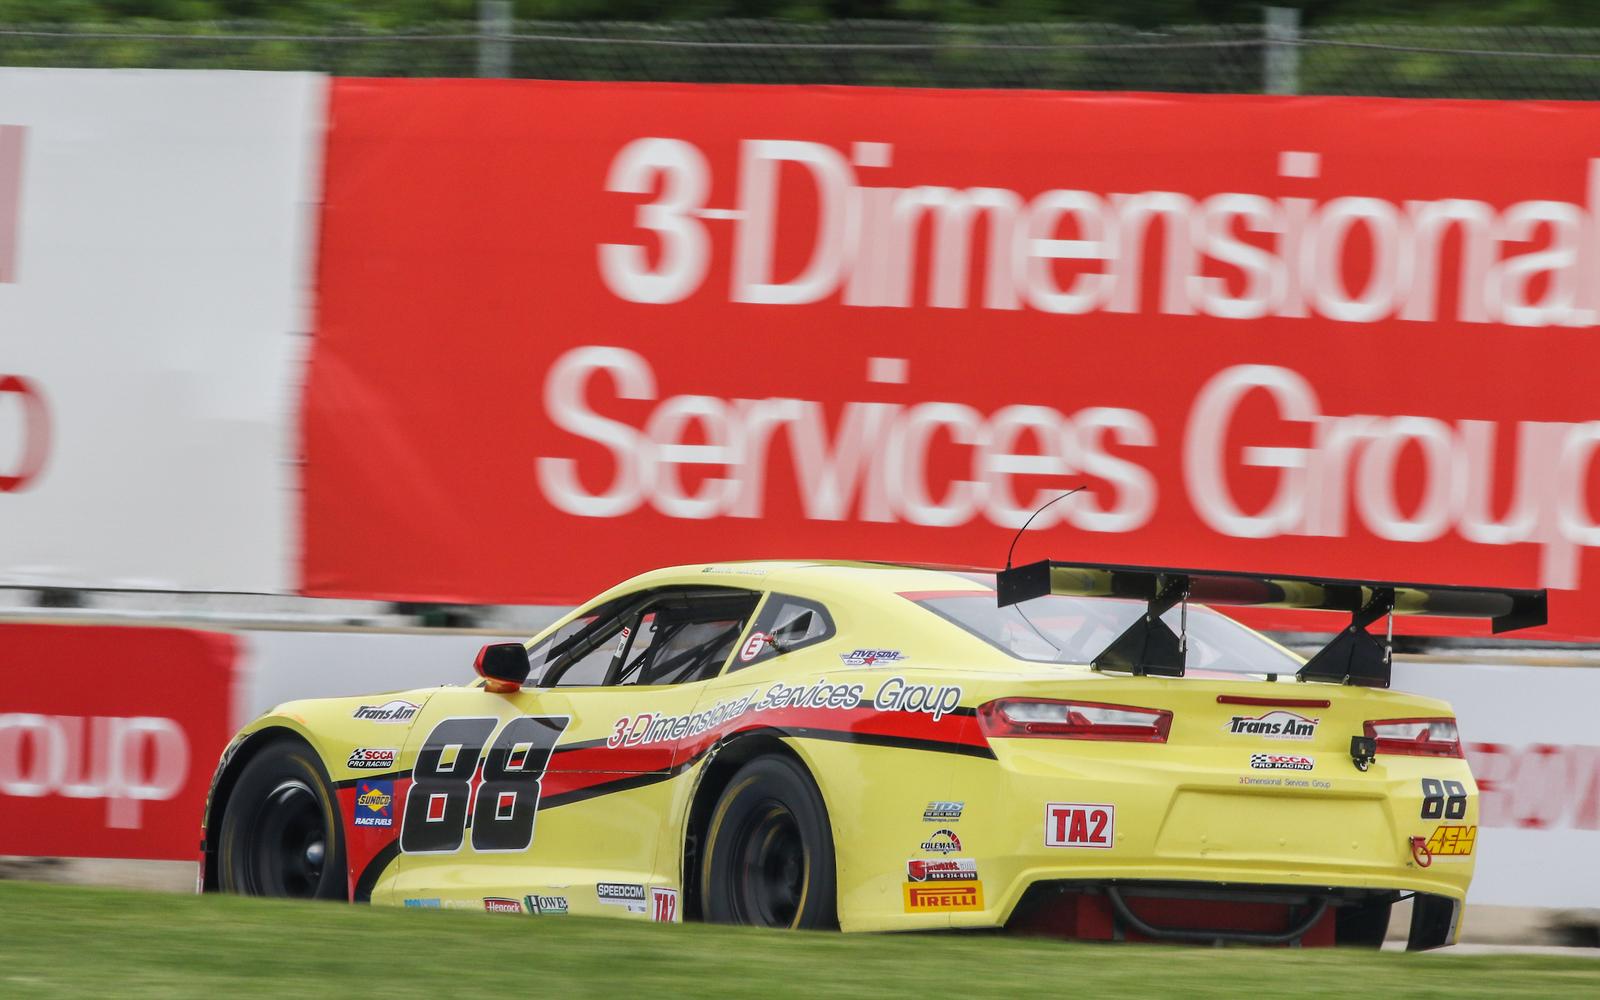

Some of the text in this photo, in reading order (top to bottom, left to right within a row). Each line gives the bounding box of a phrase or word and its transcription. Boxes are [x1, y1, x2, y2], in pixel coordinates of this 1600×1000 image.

[534, 345, 1600, 590] Services Group
[850, 650, 876, 659] FIVE
[353, 705, 416, 720] Trans Am
[607, 676, 961, 749] 3-Dimensional Services Group
[1231, 716, 1314, 736] Trans Am
[364, 750, 393, 760] SCCA
[1268, 755, 1311, 764] SCCA
[348, 760, 391, 768] PRO RACING
[400, 715, 571, 855] 88
[1285, 778, 1309, 787] Services
[1312, 779, 1331, 789] Group
[359, 794, 390, 806] SUNOCO
[1421, 778, 1467, 819] 88
[354, 817, 392, 826] RACE FUELS
[1052, 809, 1108, 843] TA2
[920, 842, 956, 850] COLEMAN
[1421, 826, 1477, 856] AEM
[598, 885, 643, 899] SPEEDCOM
[909, 887, 977, 907] PIRELLI
[654, 892, 676, 922] TA2
